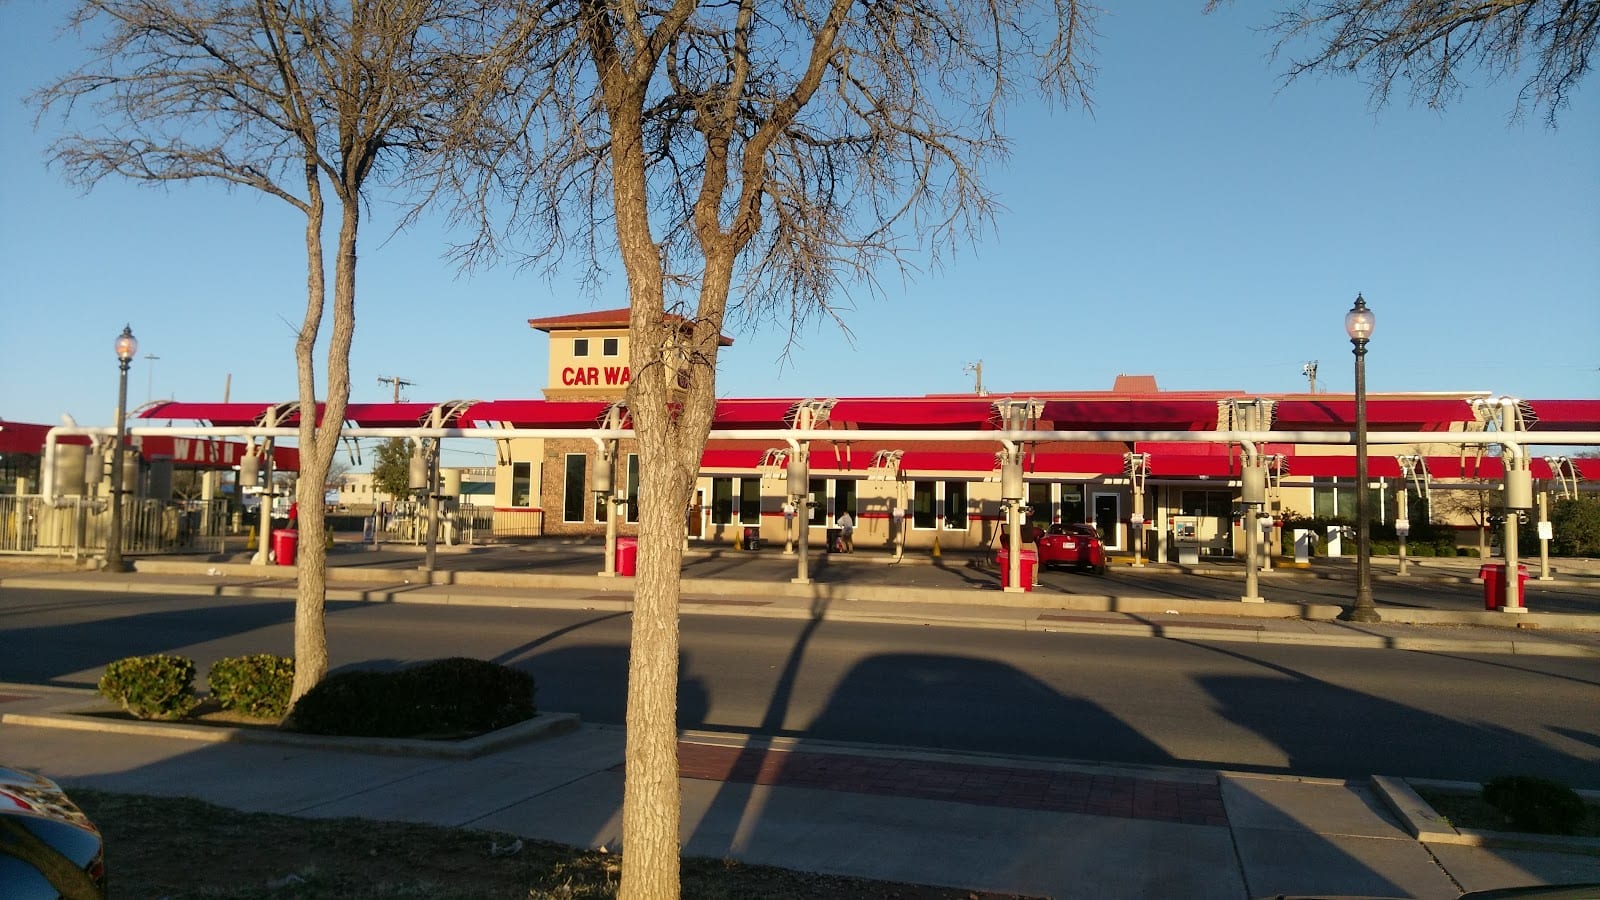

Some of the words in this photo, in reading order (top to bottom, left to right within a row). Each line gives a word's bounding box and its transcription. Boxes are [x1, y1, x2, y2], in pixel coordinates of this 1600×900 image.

[562, 367, 599, 386] CAR
[604, 366, 631, 386] WA
[173, 438, 235, 464] WASH
